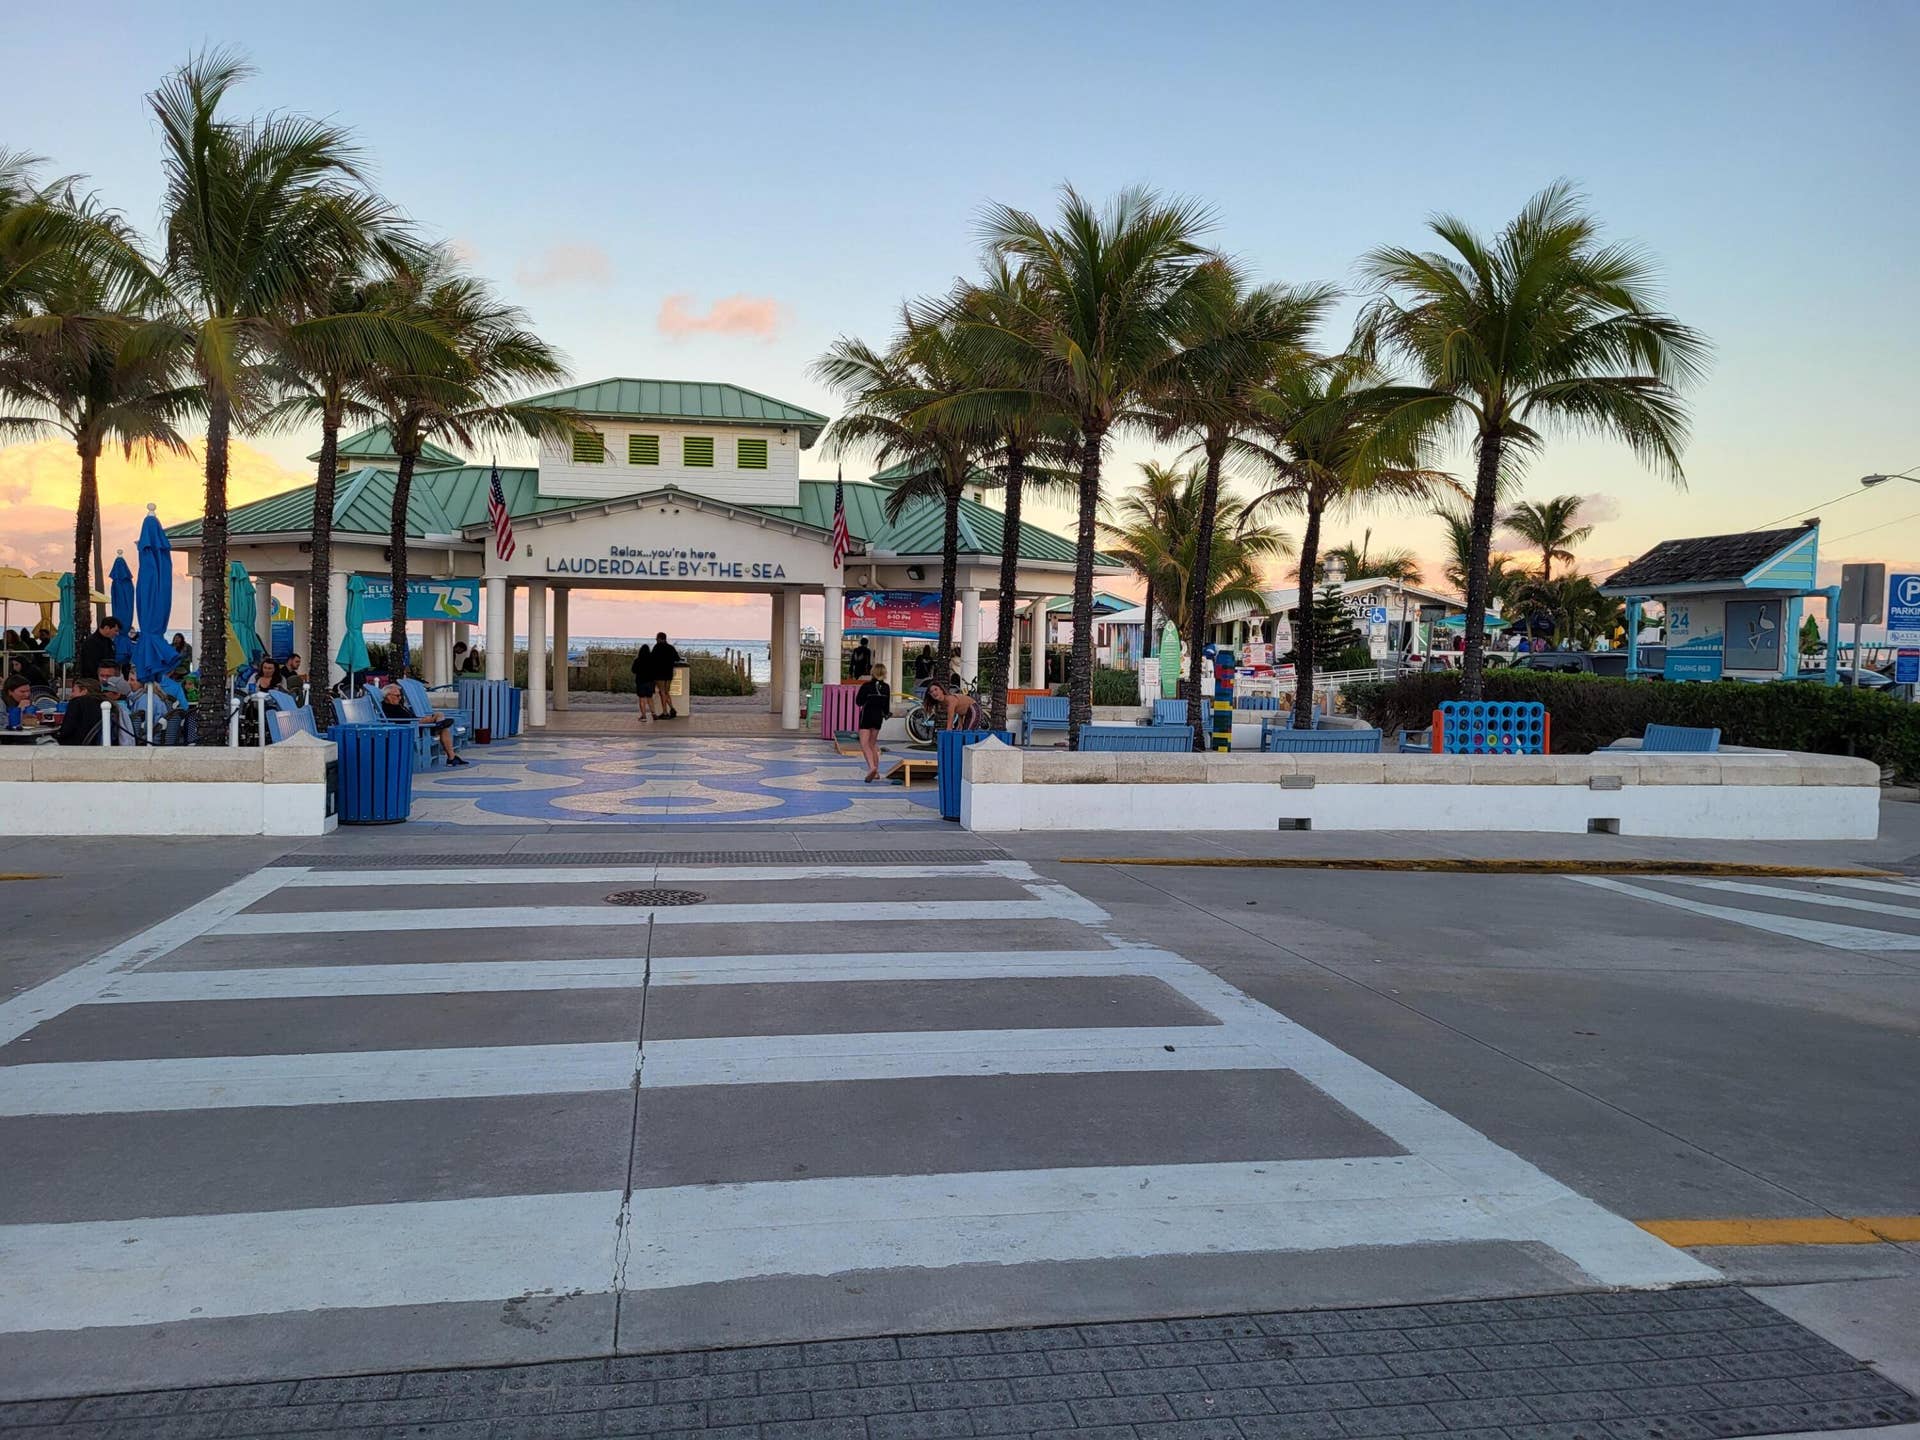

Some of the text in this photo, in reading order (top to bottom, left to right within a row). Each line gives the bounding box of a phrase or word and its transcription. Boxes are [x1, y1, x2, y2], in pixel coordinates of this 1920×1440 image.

[690, 547, 716, 559] here
[545, 556, 786, 579] LAUDERDALE BY THE SEA
[429, 586, 473, 614] 75
[1670, 612, 1689, 628] 24
